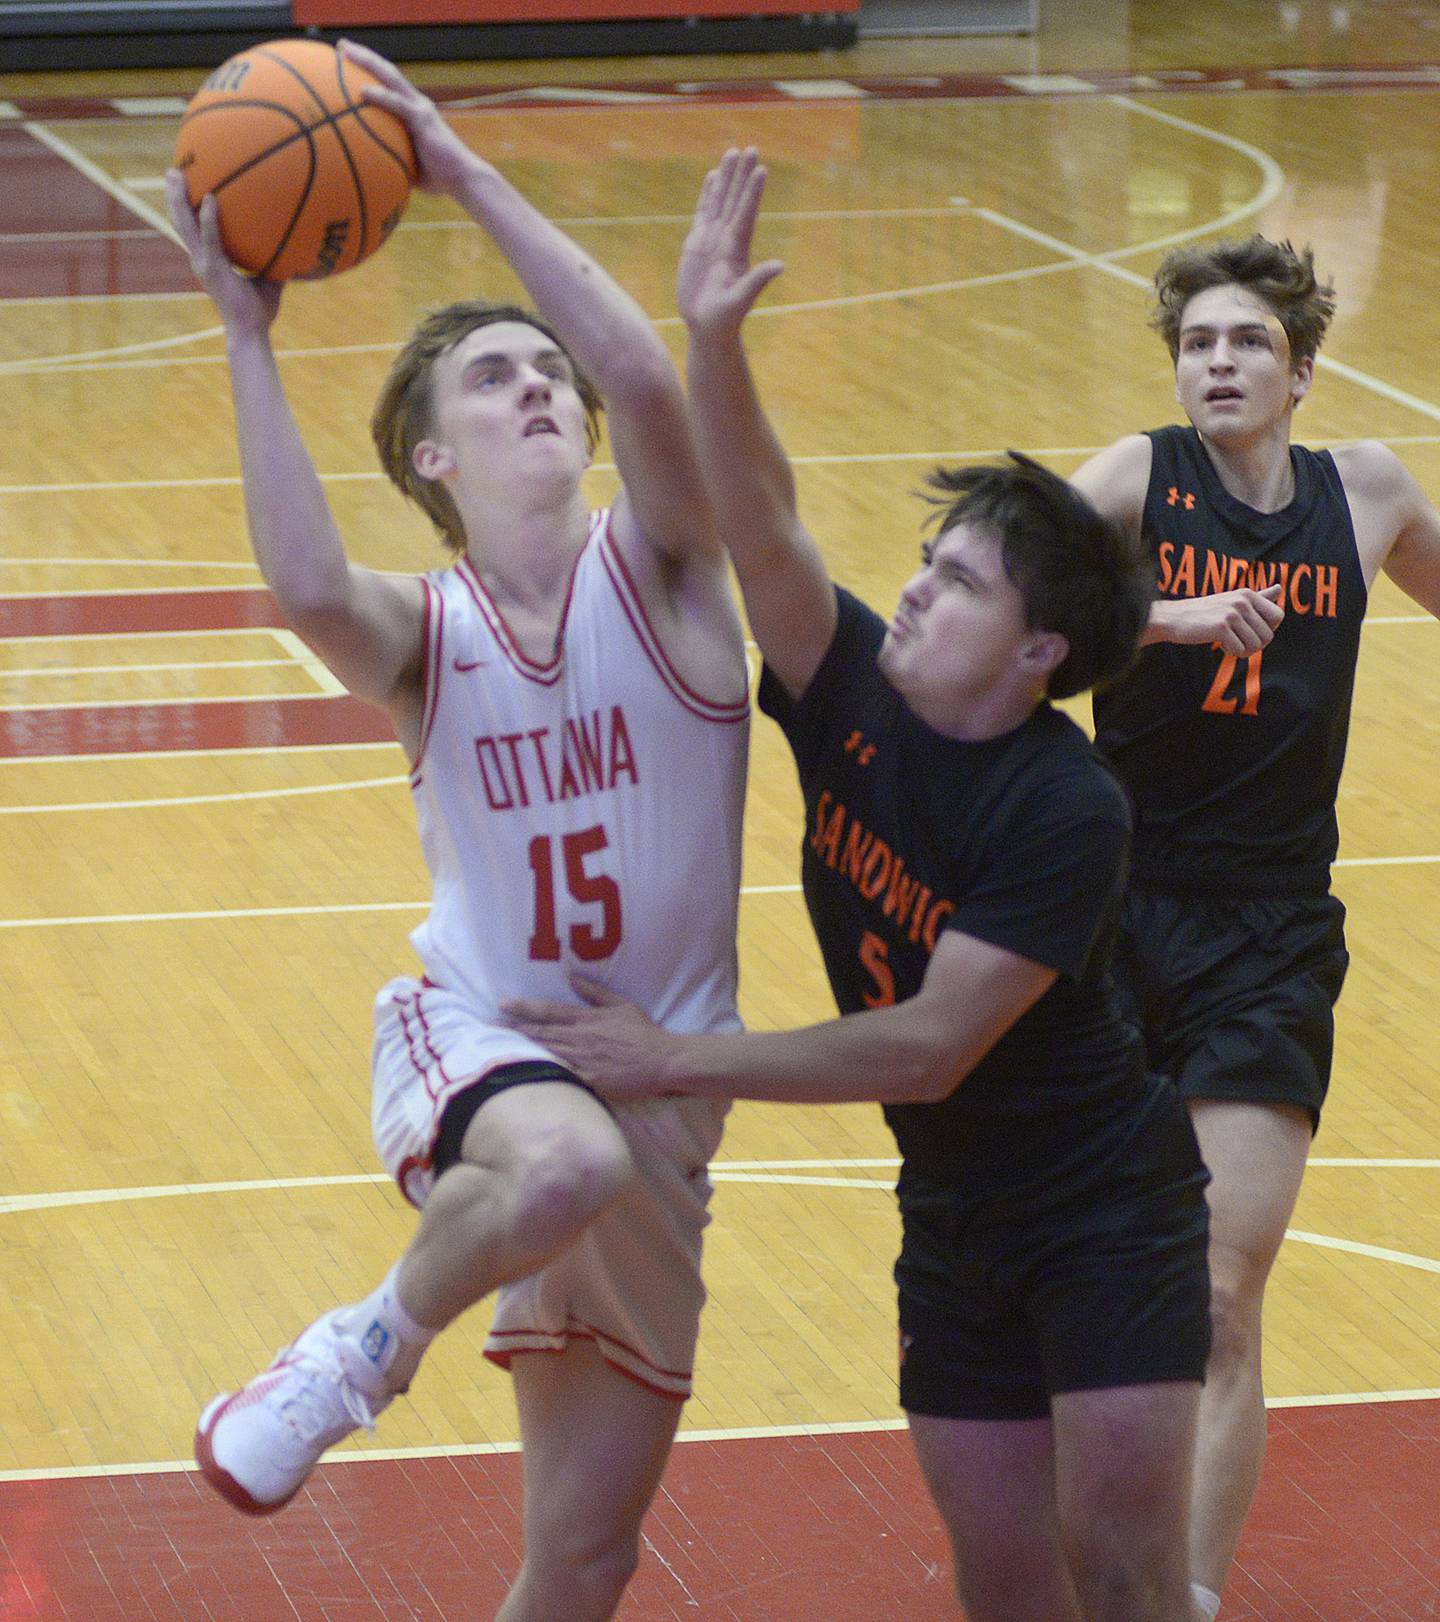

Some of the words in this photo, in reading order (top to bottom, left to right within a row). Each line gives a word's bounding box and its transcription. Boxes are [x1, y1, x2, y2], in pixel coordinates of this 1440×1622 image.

[1157, 541, 1338, 618] SANDWICH
[1201, 641, 1263, 716] 21
[475, 705, 639, 810] OTTAWA
[528, 824, 622, 961] 15
[811, 789, 957, 953] SANDWIC
